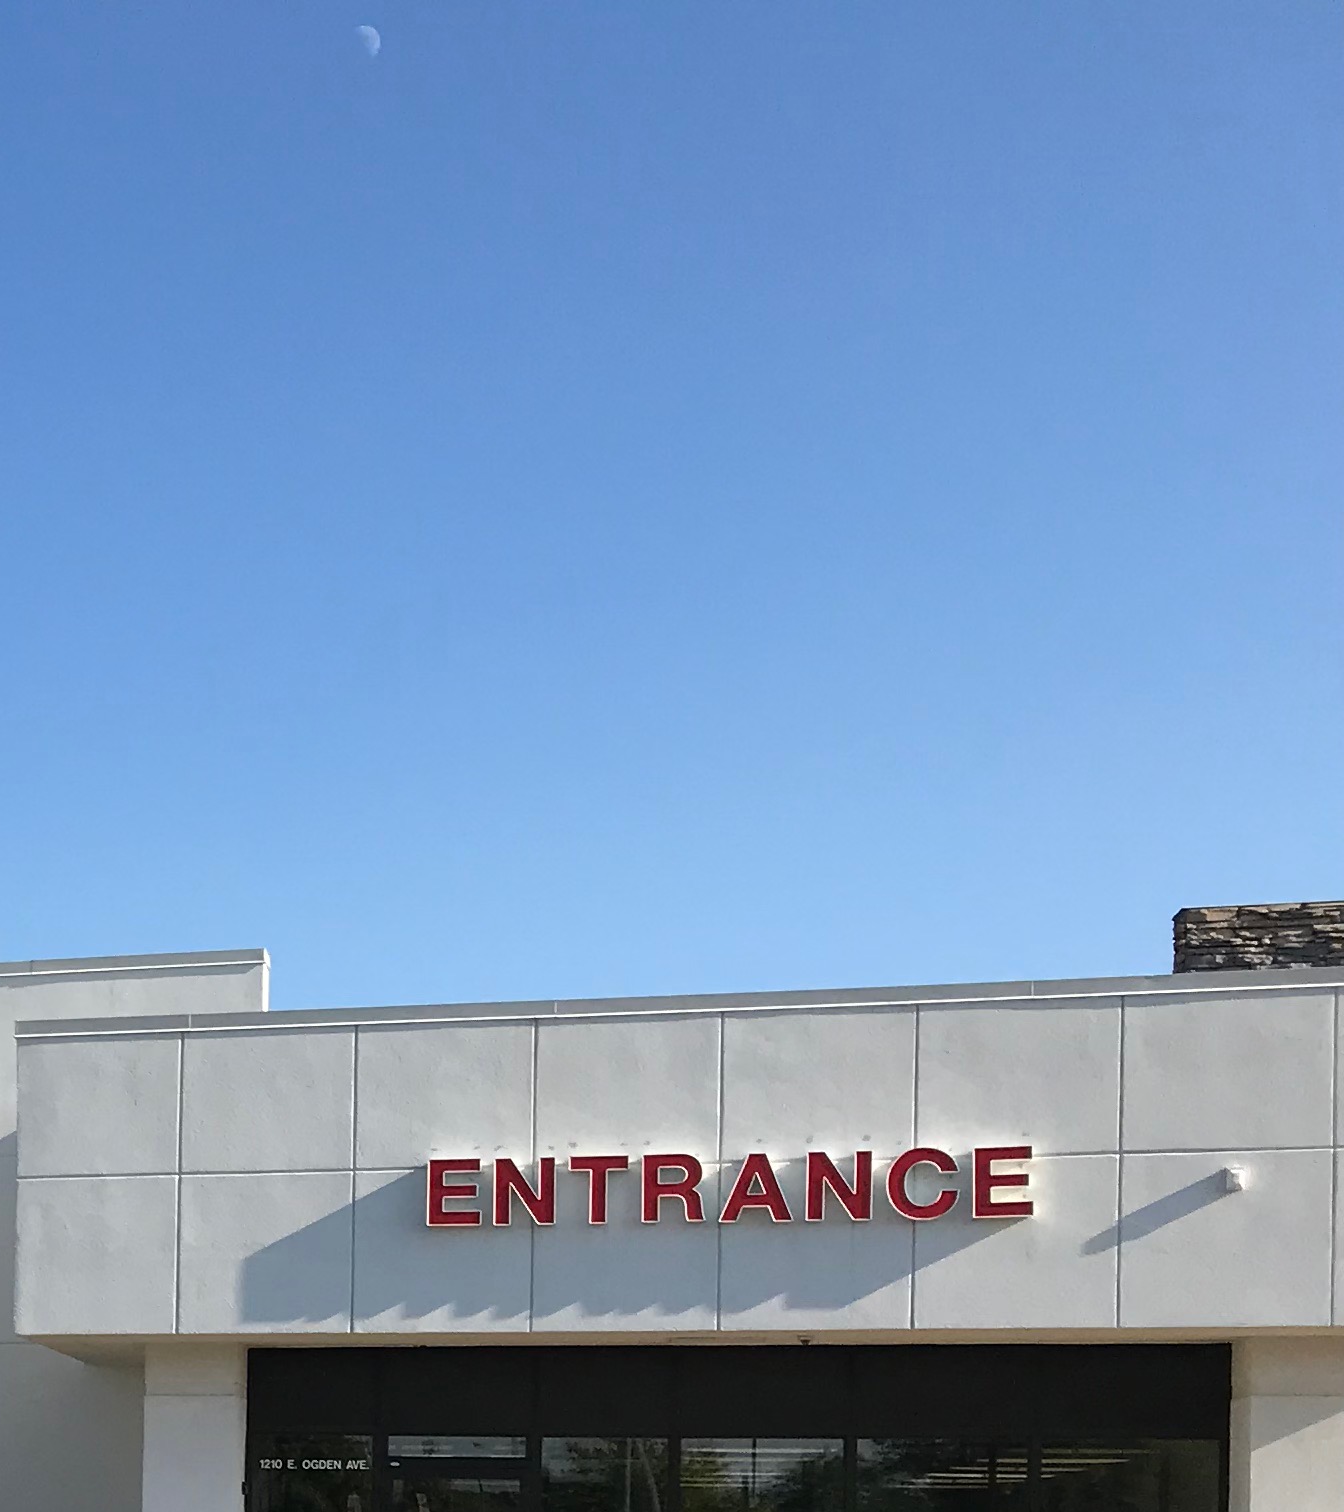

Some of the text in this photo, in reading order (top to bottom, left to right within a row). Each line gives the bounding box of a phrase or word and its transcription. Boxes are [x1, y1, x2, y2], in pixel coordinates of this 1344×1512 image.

[426, 1145, 1034, 1228] ENTRANCE
[259, 1459, 283, 1470] 1210
[302, 1459, 342, 1470] OGDEN
